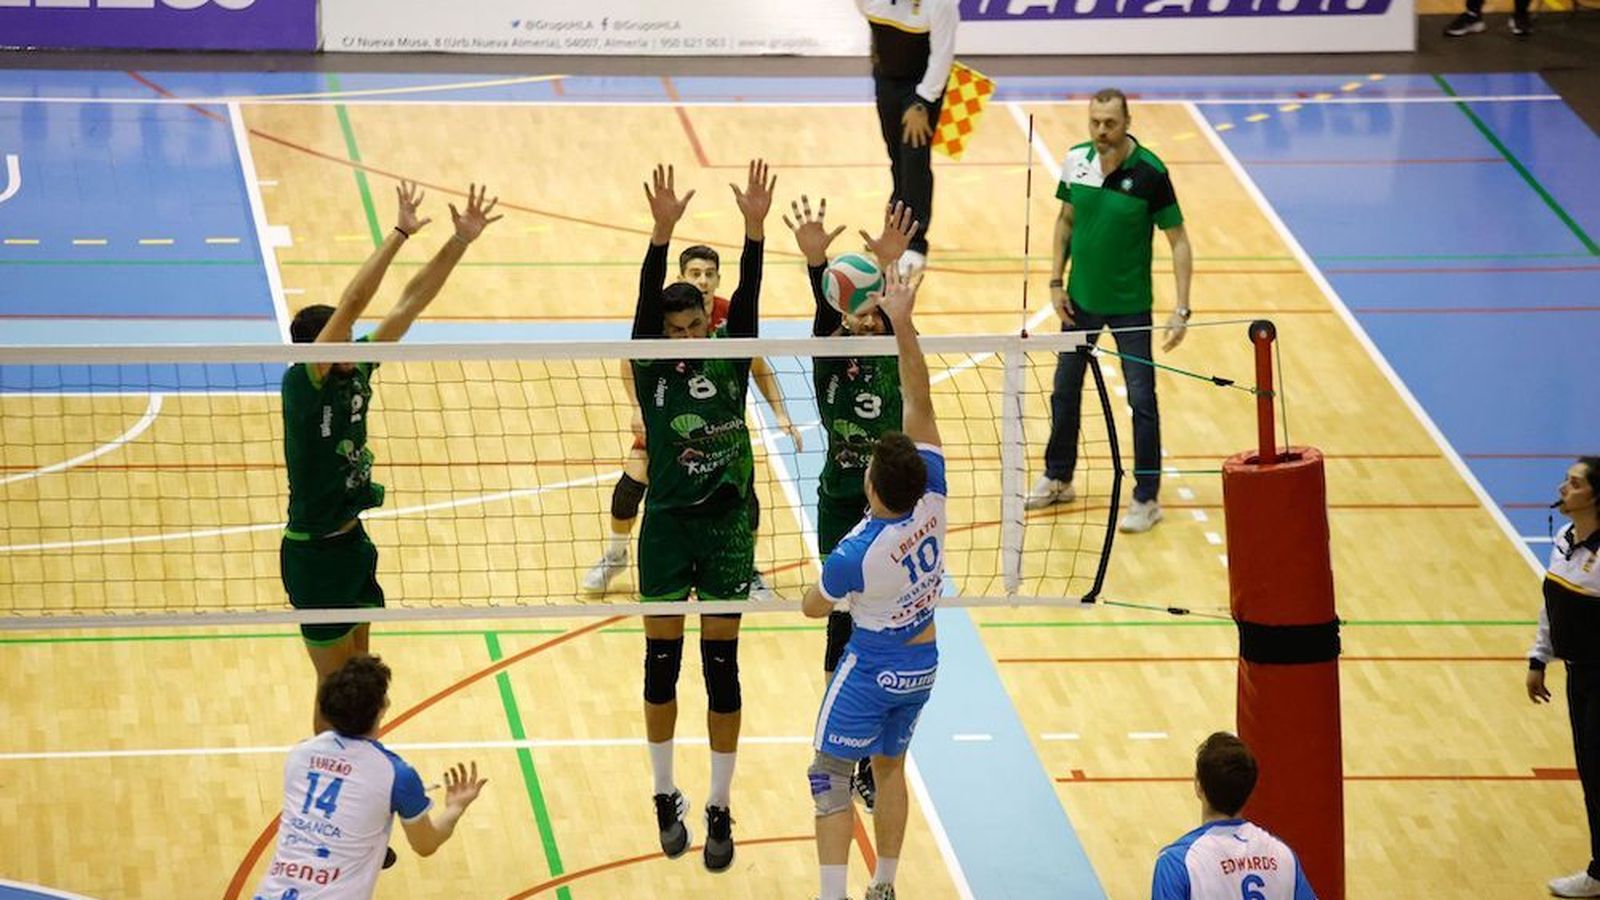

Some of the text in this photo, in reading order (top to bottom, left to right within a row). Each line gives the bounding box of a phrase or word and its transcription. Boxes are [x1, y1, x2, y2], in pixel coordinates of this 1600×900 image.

[357, 37, 395, 48] Nueva
[687, 375, 718, 400] 8
[854, 392, 882, 419] 3
[901, 535, 940, 585] 10
[302, 771, 344, 820] 14
[271, 861, 342, 885] arenal
[1220, 856, 1279, 875] EDWARDS
[1241, 873, 1267, 900] 6
